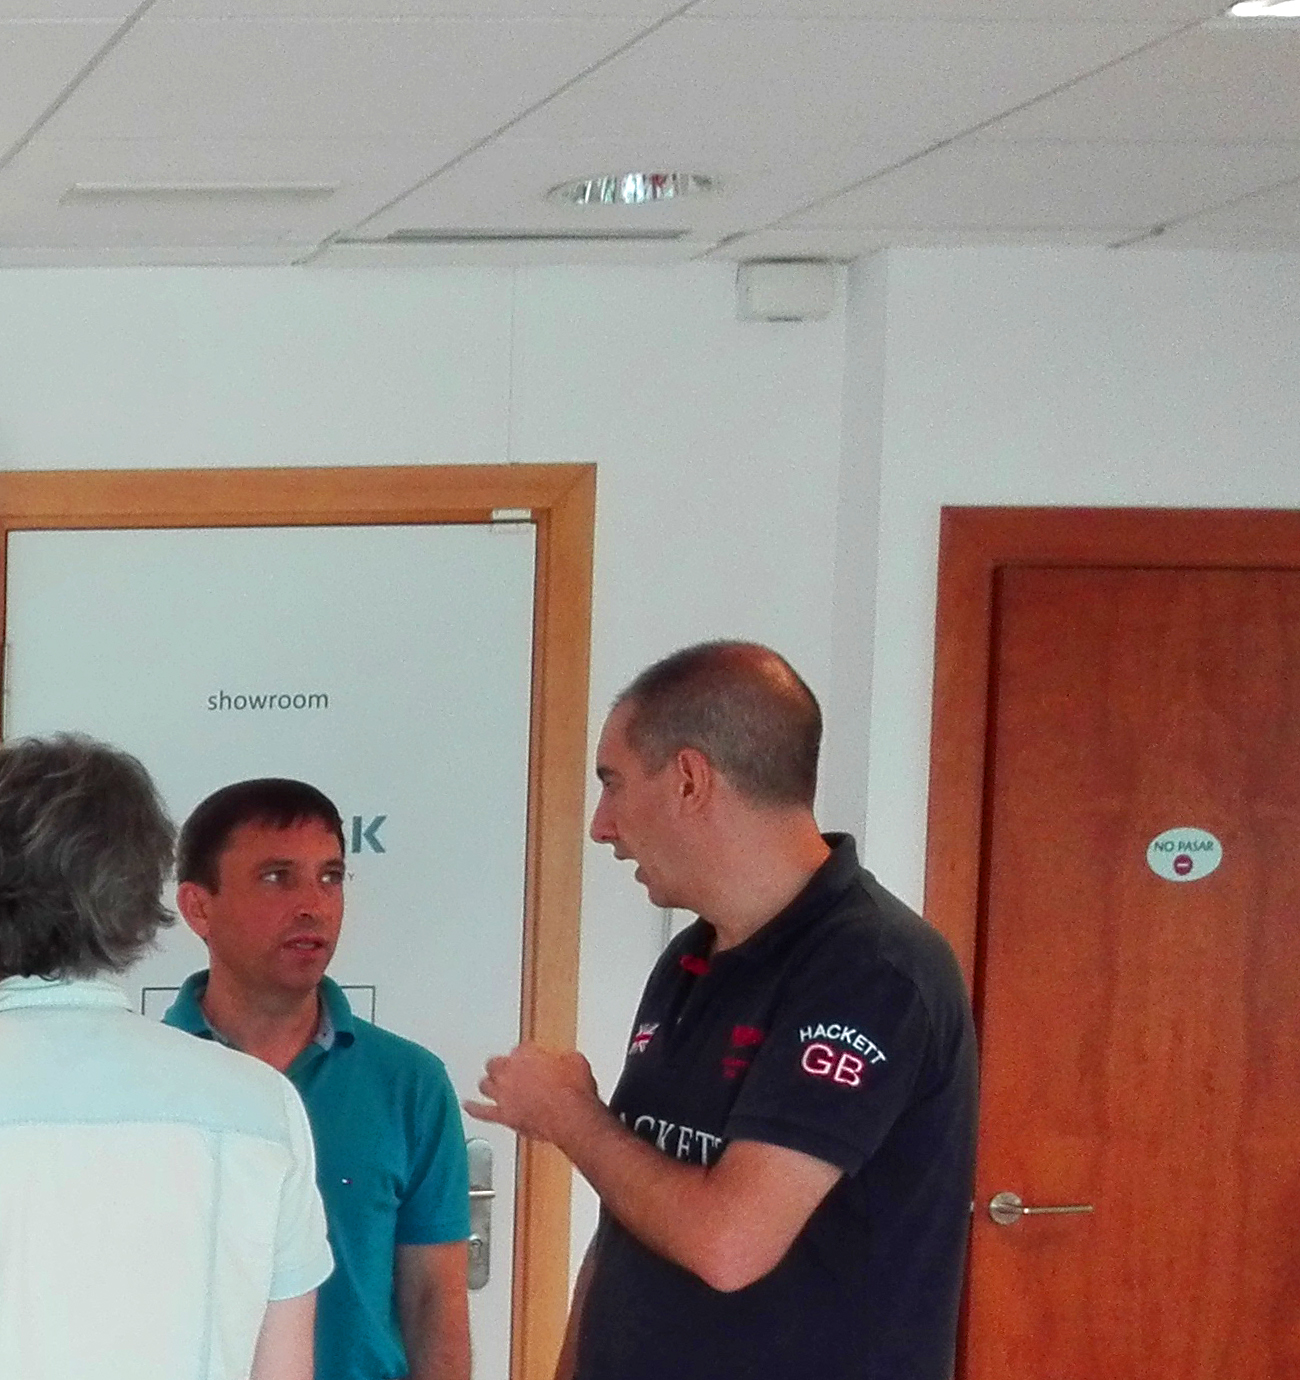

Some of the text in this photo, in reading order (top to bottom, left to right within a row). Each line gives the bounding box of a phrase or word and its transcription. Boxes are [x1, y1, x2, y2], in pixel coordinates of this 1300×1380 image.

[207, 689, 329, 711] showroom
[1154, 840, 1214, 853] NO PASAR
[799, 1023, 887, 1065] HACKETT
[801, 1043, 864, 1087] GB
